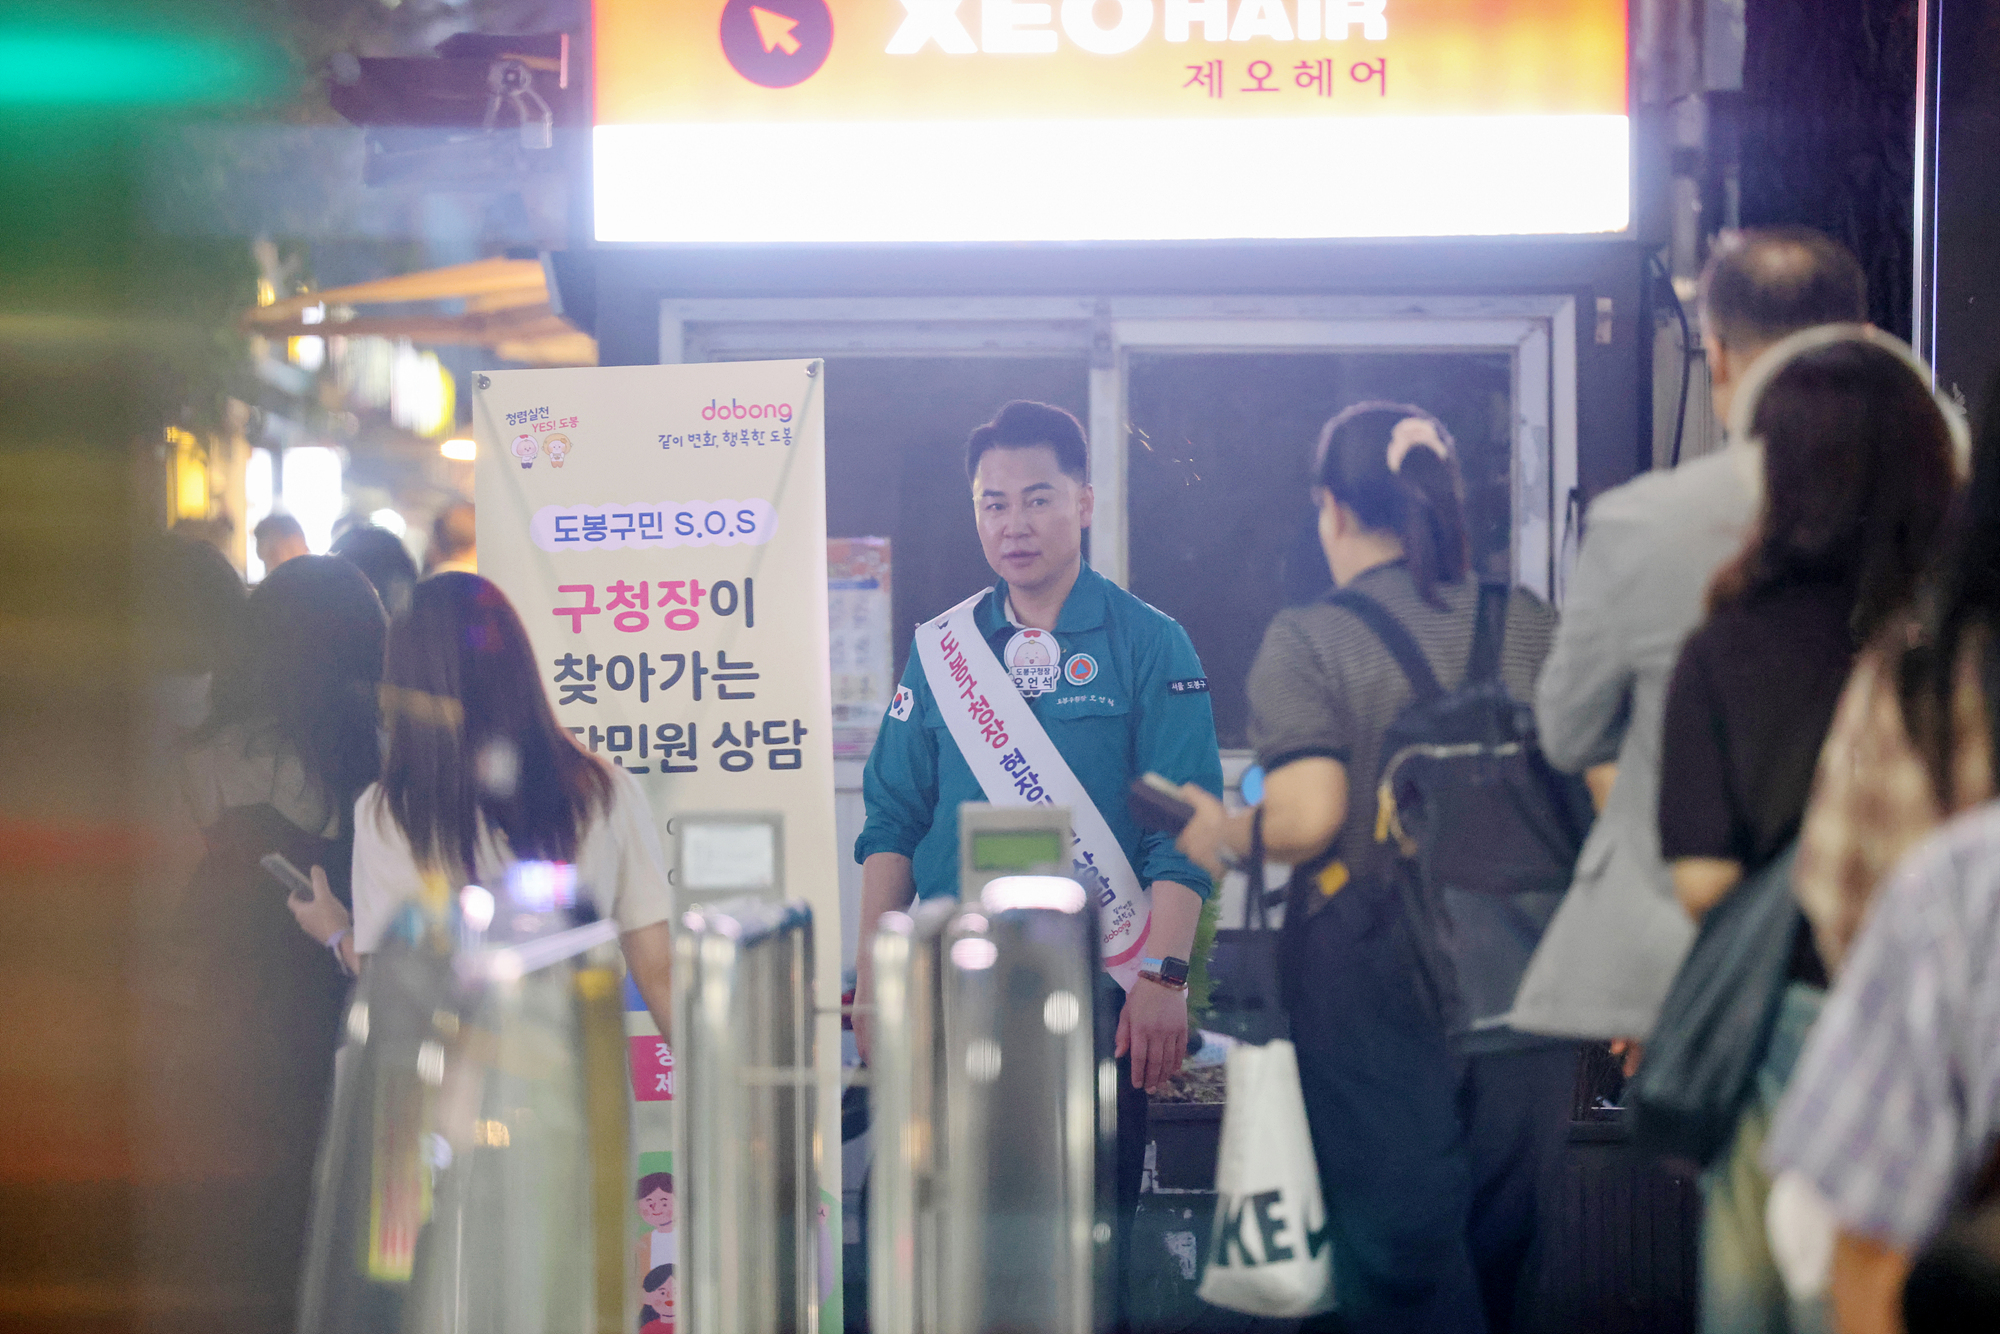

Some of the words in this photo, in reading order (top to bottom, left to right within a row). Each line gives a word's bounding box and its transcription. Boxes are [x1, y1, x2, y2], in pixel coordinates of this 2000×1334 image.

[884, 0, 1154, 54] XEO
[1165, 0, 1387, 42] HAIR
[1183, 57, 1388, 98] 제오헤어
[505, 406, 549, 426] 청렴실천
[532, 420, 556, 433] YES!
[559, 416, 579, 429] 도봉
[702, 398, 792, 423] dobong
[658, 434, 683, 449] 같이
[722, 428, 765, 447] 행복한
[770, 427, 792, 446] 도봉
[554, 511, 663, 542] 도봉구민
[675, 509, 756, 538] S.O.S
[552, 577, 754, 634] 구청장이
[554, 650, 760, 705] 찾아가는
[1016, 667, 1051, 676] 도봉구청장
[1187, 680, 1206, 690] 도봉구
[940, 630, 1009, 749] 도봉구청장
[712, 719, 808, 772] 상담
